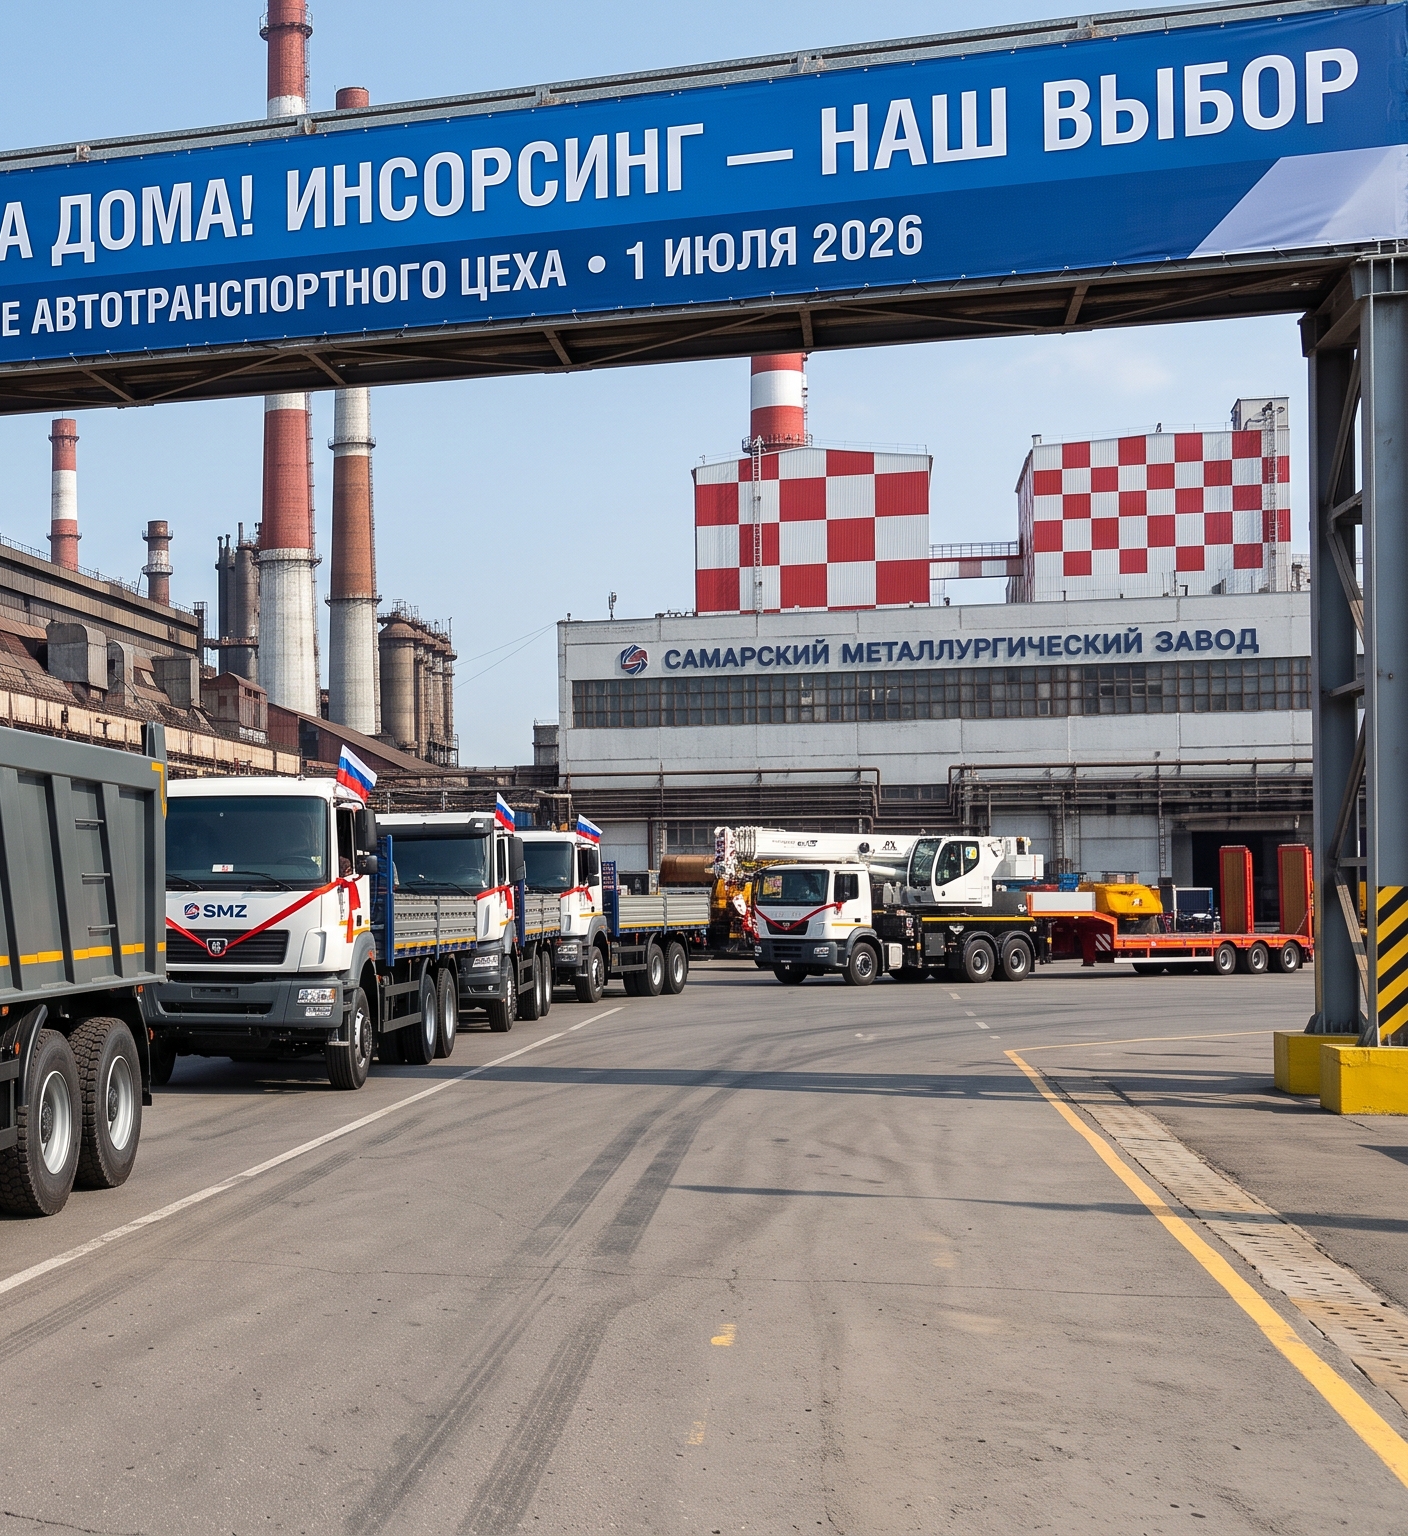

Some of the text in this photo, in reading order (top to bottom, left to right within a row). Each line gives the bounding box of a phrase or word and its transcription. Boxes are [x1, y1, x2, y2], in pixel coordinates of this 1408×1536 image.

[51, 174, 254, 267] ДОМА!
[287, 122, 705, 232] ИНСОРСИНГ
[821, 86, 1007, 176] НАШ
[1043, 47, 1360, 152] ВЫБОР
[31, 260, 446, 334] АВТОТРАНСПОРТНОГО
[461, 249, 567, 303] ЦЕХА
[626, 241, 644, 280] 1
[664, 226, 797, 278] ИЮЛЯ
[813, 214, 923, 264] 2026
[664, 627, 1260, 669] САМАРСКИЙ МЕТАЛЛУРГИЧЕСКИЙ ЗАВОД
[203, 904, 248, 918] SMZ
